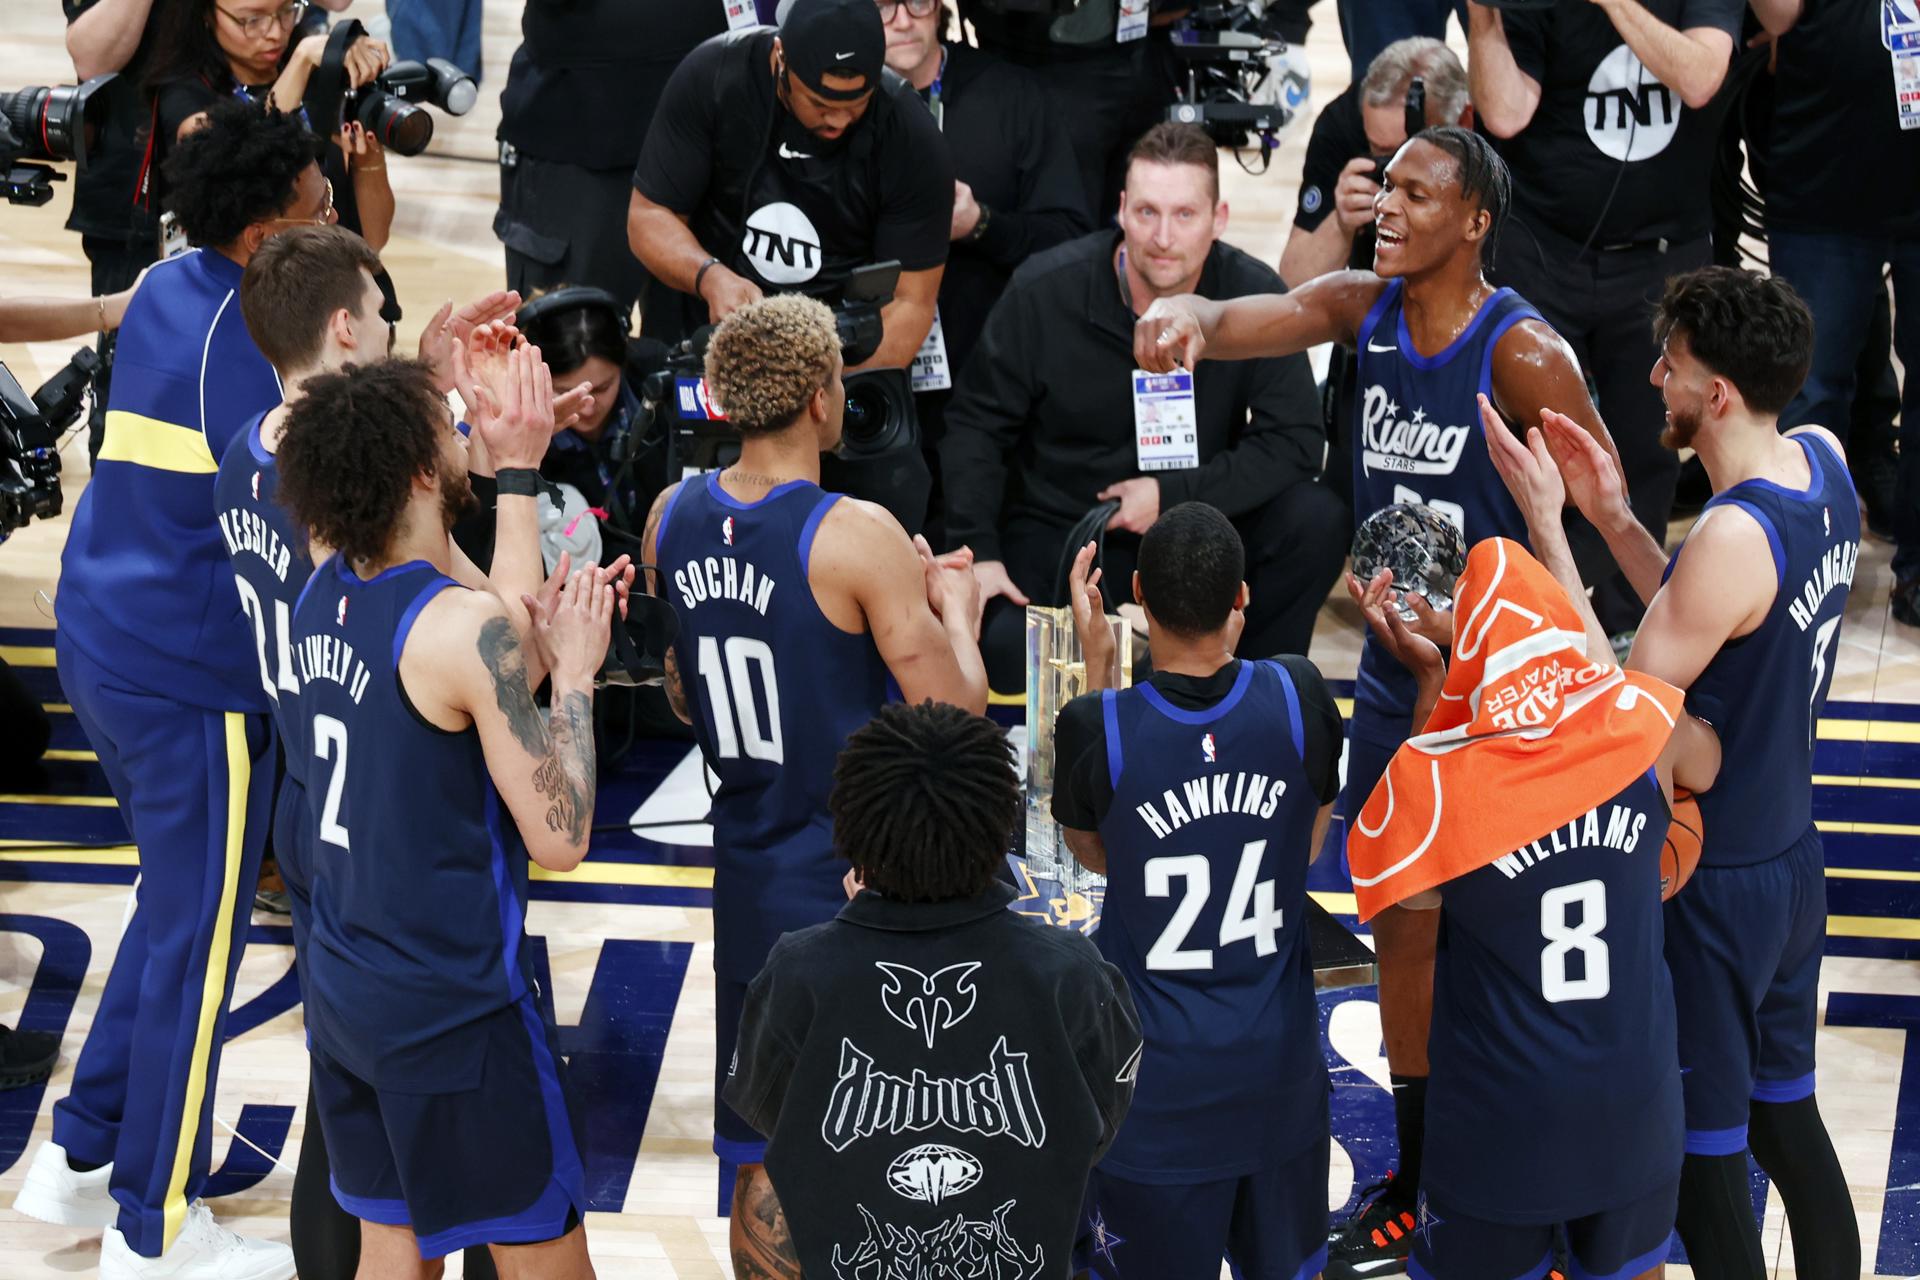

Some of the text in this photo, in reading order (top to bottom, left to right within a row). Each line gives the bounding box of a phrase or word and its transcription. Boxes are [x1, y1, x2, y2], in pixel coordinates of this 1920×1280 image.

[1586, 82, 1673, 131] TNT
[746, 226, 821, 269] TNT
[679, 385, 698, 412] NBA
[1361, 384, 1471, 466] Rising
[1383, 457, 1416, 472] STARS
[218, 508, 291, 583] KESSLER
[674, 556, 775, 616] SOCHAN
[1788, 540, 1859, 632] HOLMGRE
[298, 634, 371, 705] LIVELY II
[698, 635, 784, 766] 10
[1485, 659, 1563, 713] WATER
[313, 713, 350, 854] 2
[1136, 772, 1287, 839] HAWKINS
[1491, 805, 1647, 879] WILLIAMS
[1144, 839, 1283, 970] 24
[1540, 879, 1611, 1003] 8
